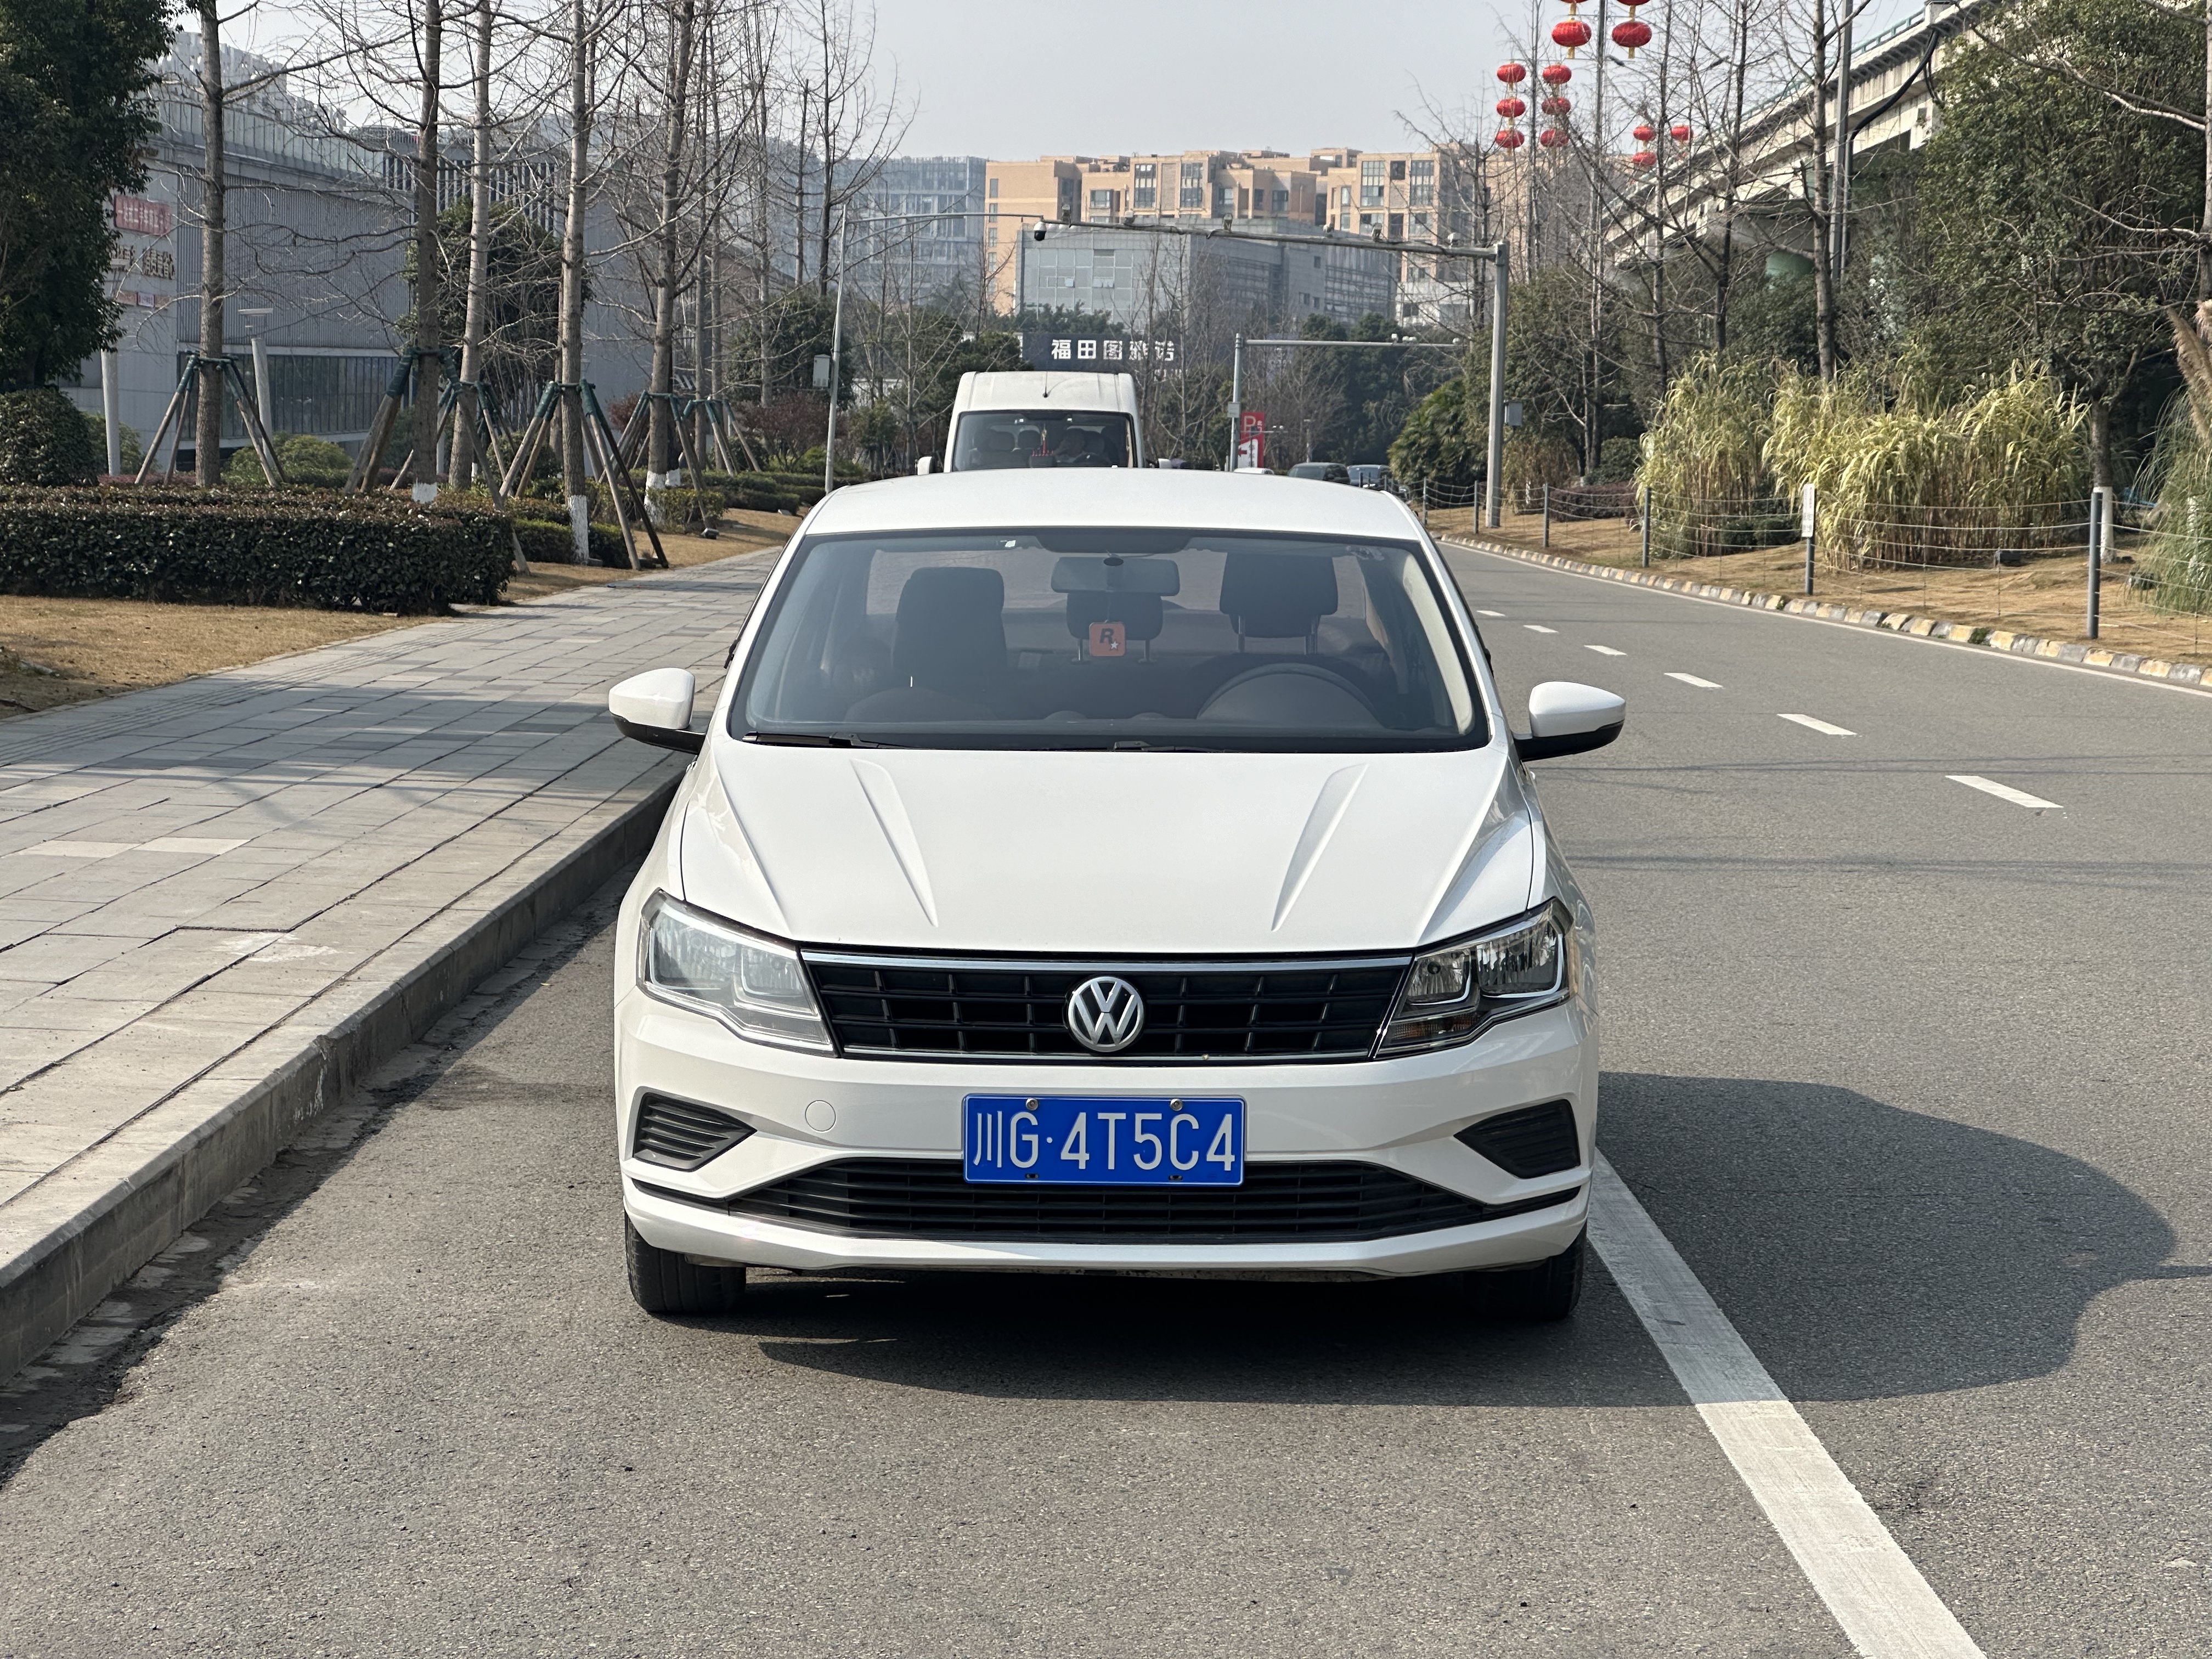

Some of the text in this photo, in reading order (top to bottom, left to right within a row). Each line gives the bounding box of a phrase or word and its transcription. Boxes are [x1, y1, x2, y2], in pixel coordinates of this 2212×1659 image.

[1052, 339, 1174, 361] 福田图雅诺
[1244, 415, 1256, 433] P
[1072, 979, 1141, 1048] VW
[973, 1110, 1235, 1171] 川G·4T5C4
